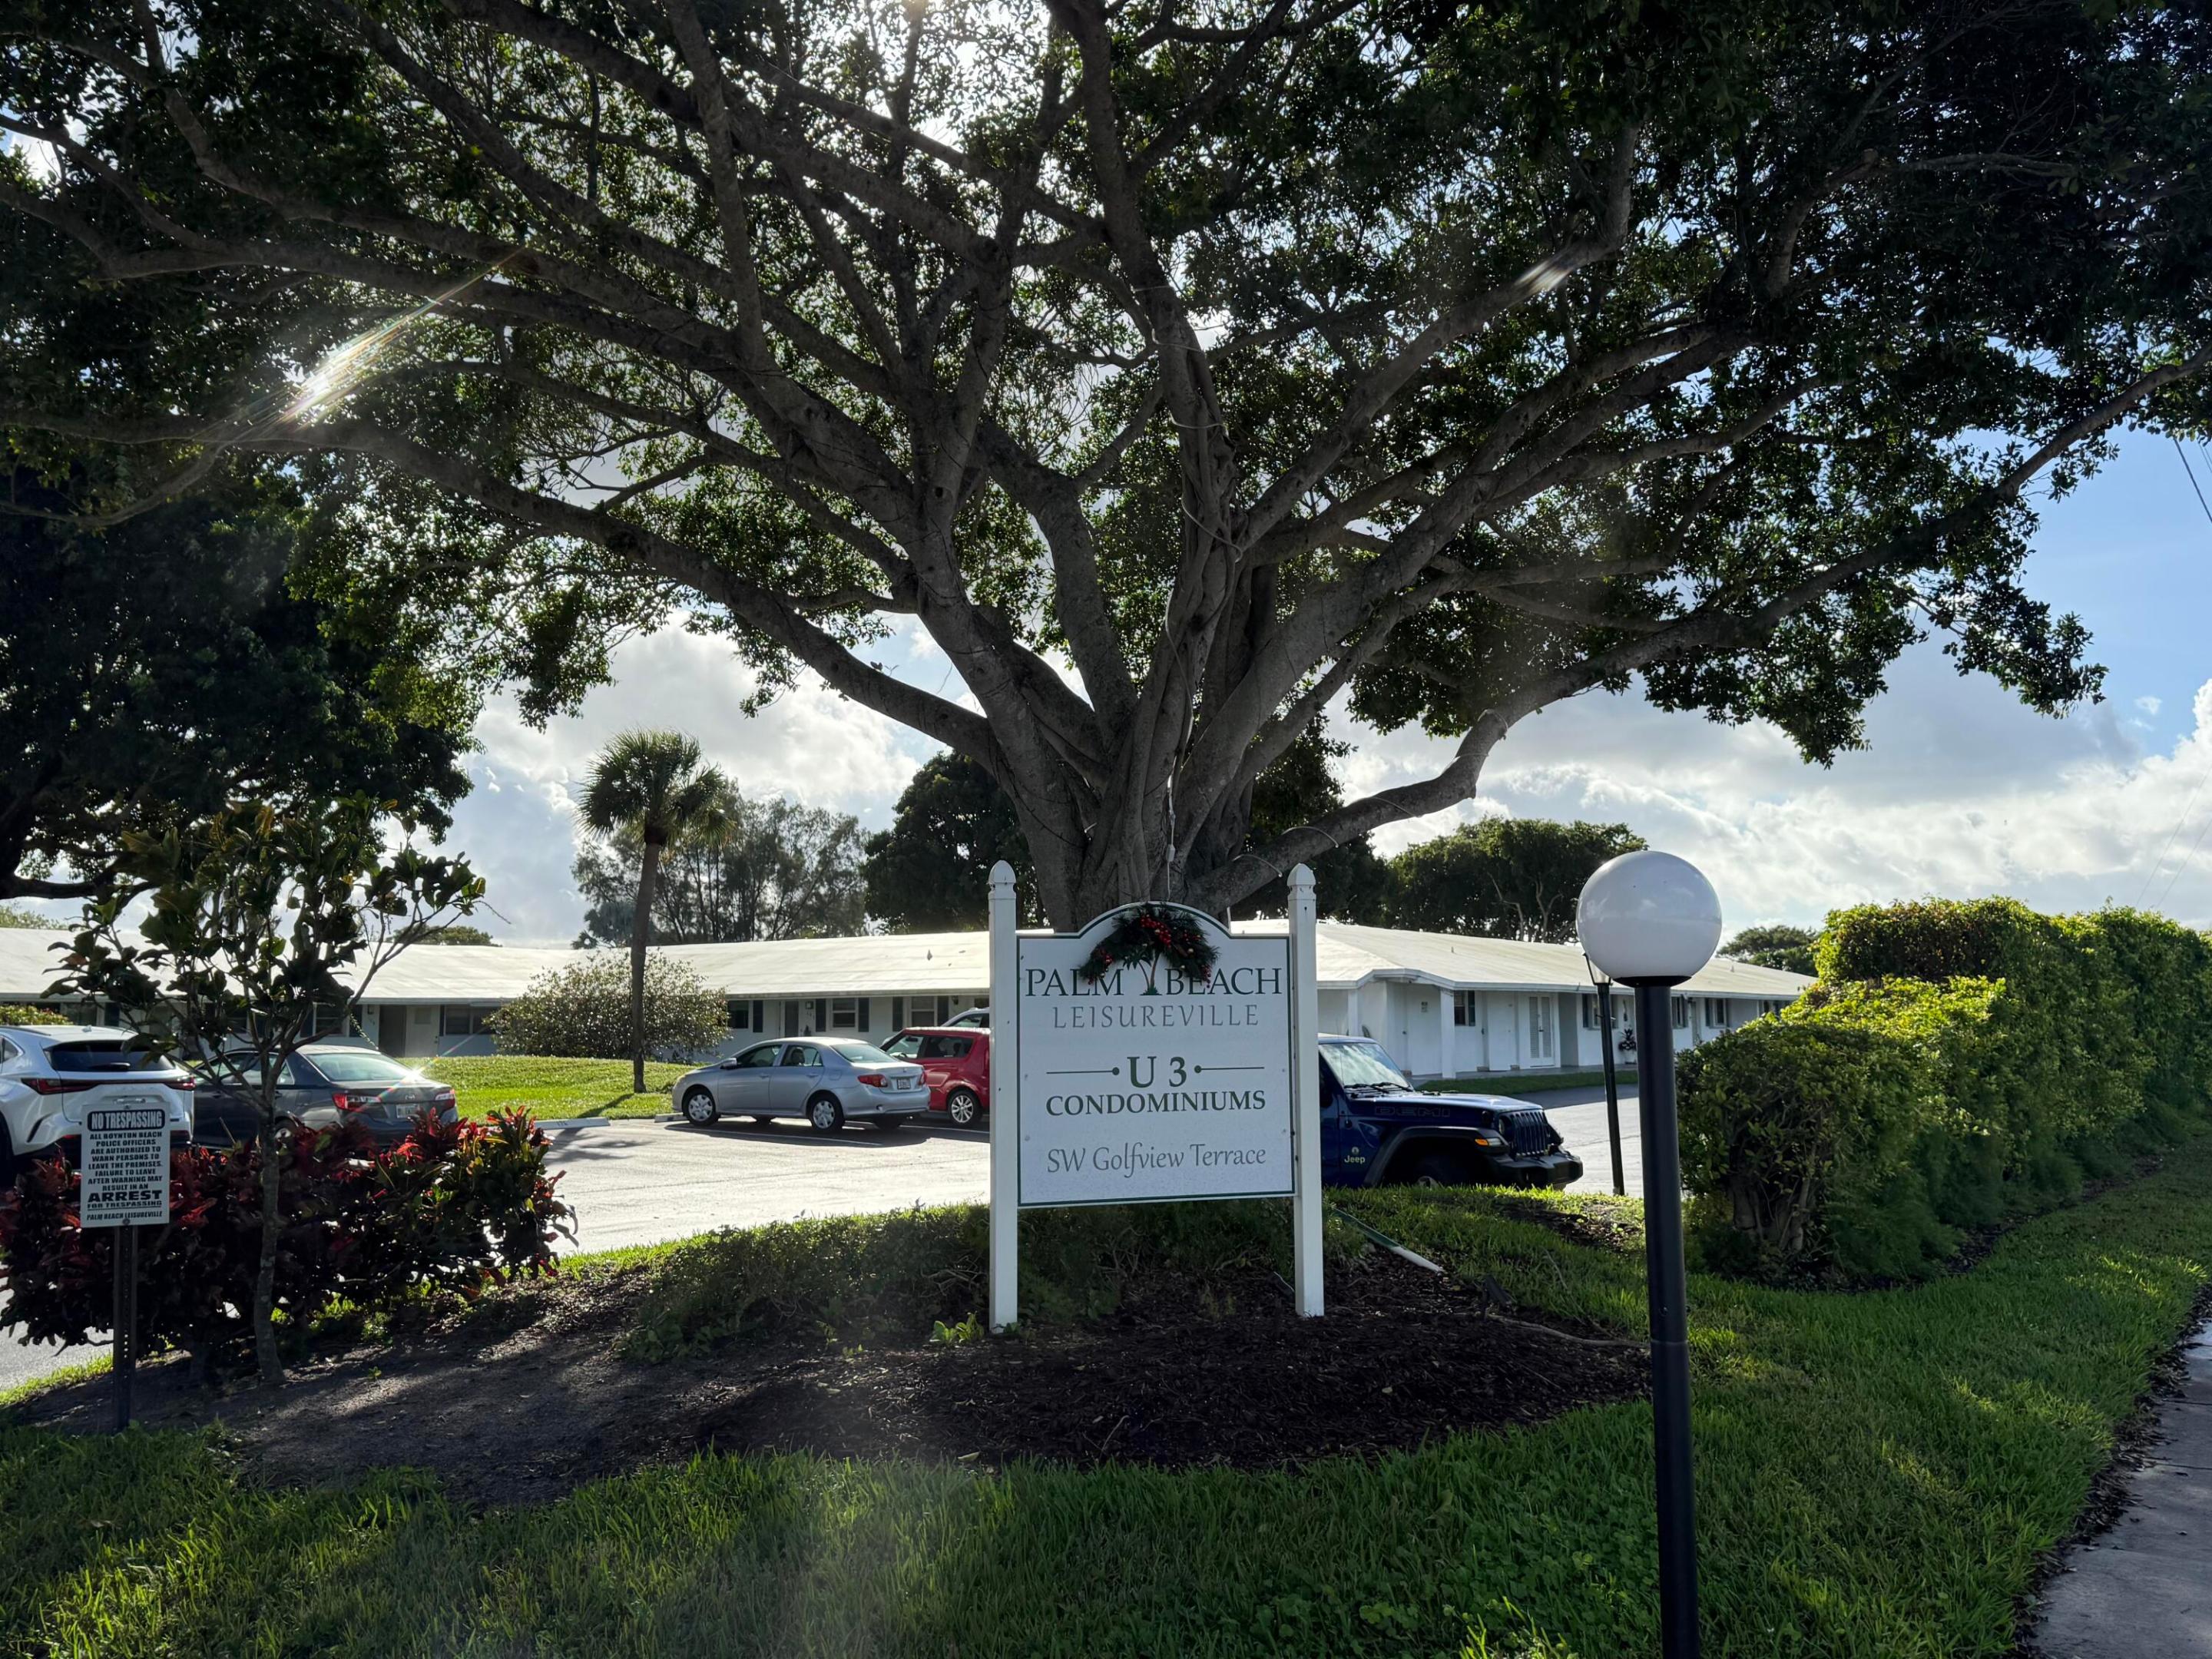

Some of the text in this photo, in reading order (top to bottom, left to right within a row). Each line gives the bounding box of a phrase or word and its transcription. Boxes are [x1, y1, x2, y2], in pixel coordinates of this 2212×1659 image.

[1025, 967, 1283, 996] PALM BEACH
[1052, 1004, 1259, 1029] LEISUREVILLE
[1127, 1055, 1187, 1088] U 3
[1046, 1090, 1266, 1116] CONDOMINIUMS
[91, 1111, 163, 1129] NO TRESPASSING
[1047, 1142, 1267, 1178] SW Golfview Terrace
[1344, 1155, 1366, 1164] Jeep
[88, 1190, 162, 1203] ARREST
